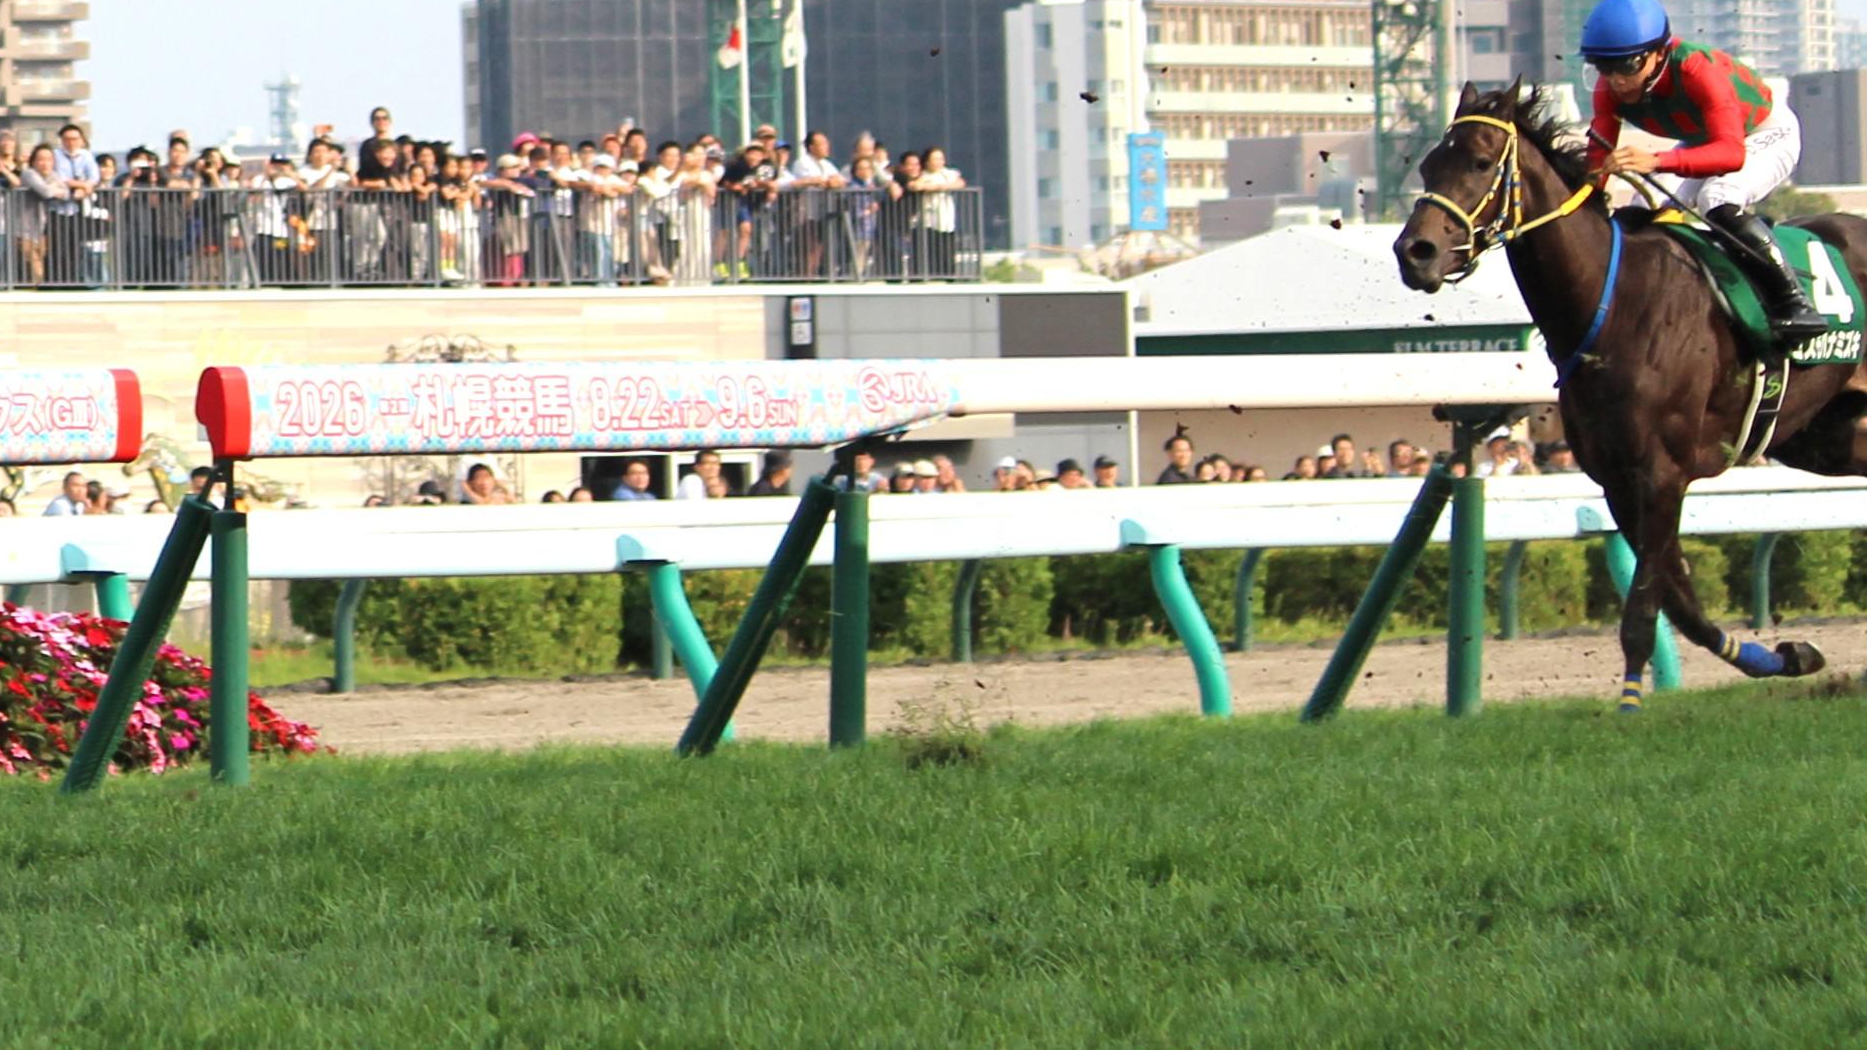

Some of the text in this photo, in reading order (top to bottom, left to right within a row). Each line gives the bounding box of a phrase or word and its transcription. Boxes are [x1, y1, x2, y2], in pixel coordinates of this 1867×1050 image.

[1807, 240, 1855, 324] 4
[275, 379, 367, 438] 2026
[412, 373, 575, 439] 札幌競馬
[890, 371, 940, 404] JRA
